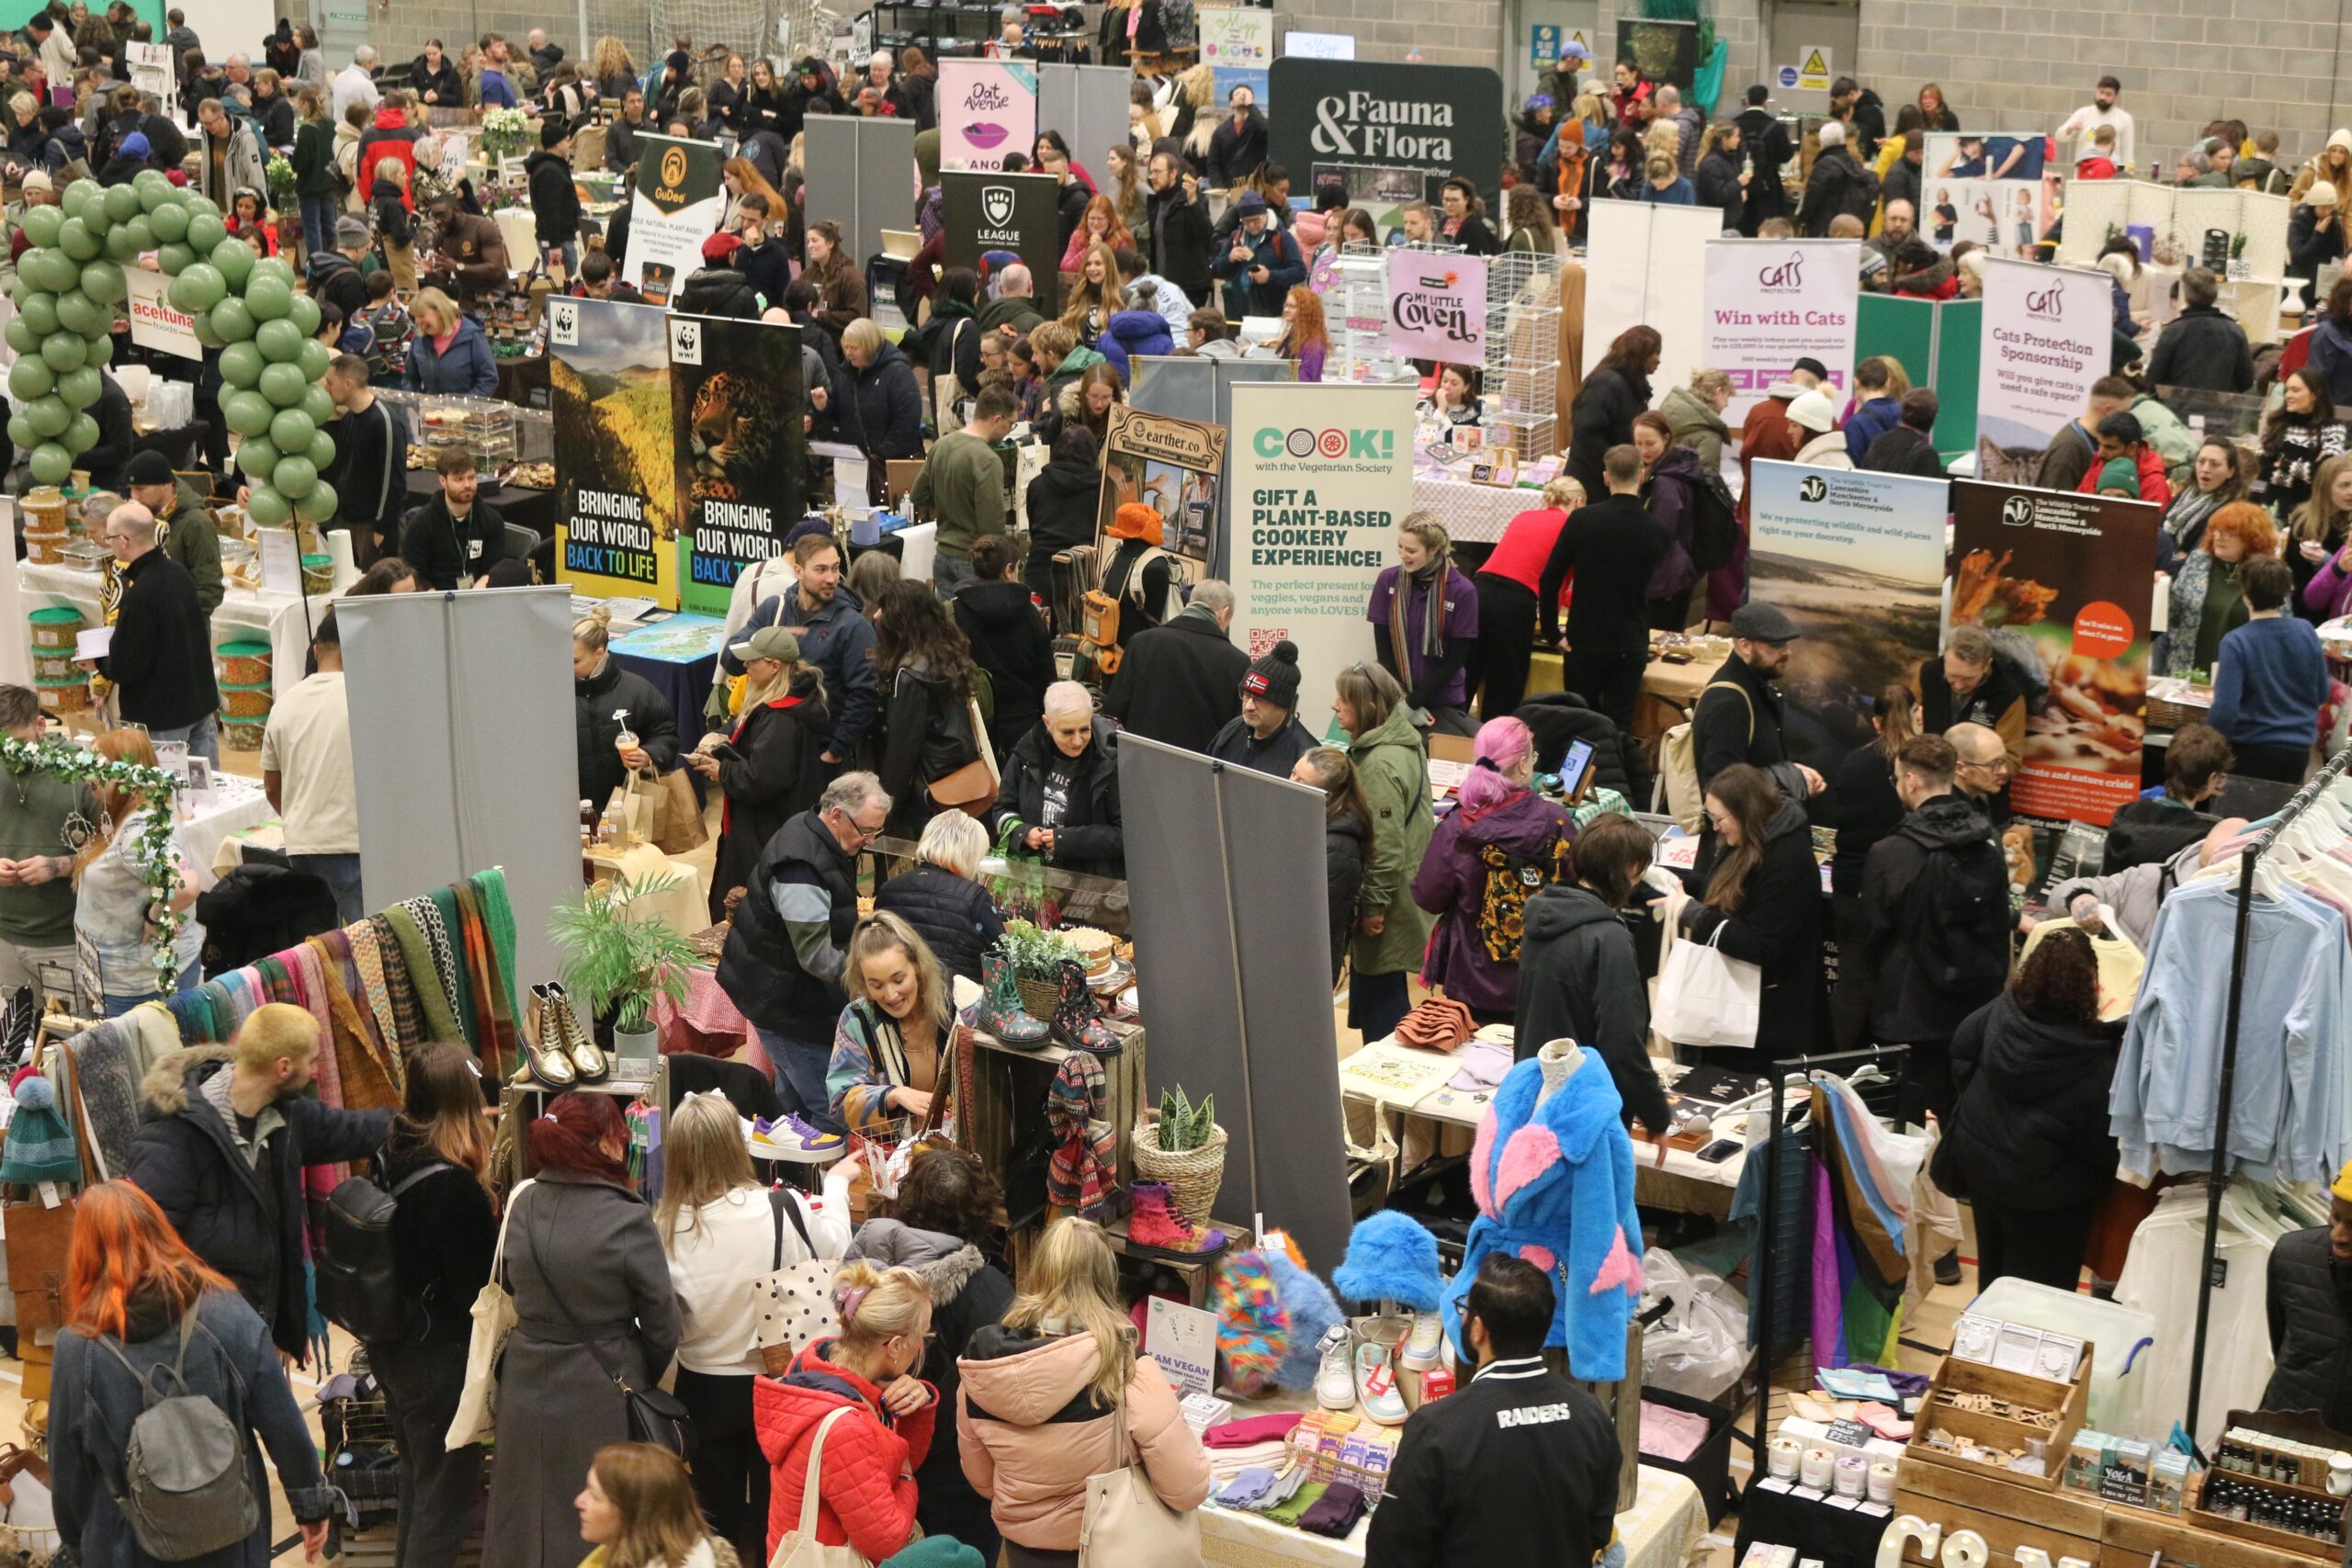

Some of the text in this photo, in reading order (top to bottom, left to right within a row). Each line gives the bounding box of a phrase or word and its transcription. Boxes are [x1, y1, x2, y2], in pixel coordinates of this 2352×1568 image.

[972, 82, 1001, 99] Oat
[964, 96, 1010, 110] Avenue
[1348, 91, 1453, 127] Fauna
[1311, 96, 1356, 155] &
[1363, 125, 1453, 161] Flora
[978, 229, 1020, 241] LEAGUE
[1759, 250, 1804, 287] CATS
[1415, 293, 1463, 308] MY LITTLE
[2027, 277, 2064, 316] CATS
[133, 302, 195, 329] aceituna
[1393, 293, 1477, 344] Coven
[1714, 310, 1846, 326] Win with Cats
[557, 333, 571, 341] WWF
[1993, 327, 2093, 356] Cats Protection
[678, 351, 694, 359] WWF
[2001, 345, 2083, 372] Sponsorship
[1997, 369, 2084, 392] Will you give cats in
[1999, 382, 2022, 393] need
[2030, 387, 2049, 398] safe
[2050, 391, 2081, 402] space?
[1147, 431, 1200, 452] earther.co
[1253, 427, 1394, 459] COOK!
[1255, 462, 1393, 475] with the Vegetarian Society
[579, 490, 642, 521] BRINGING
[1253, 490, 1317, 506] GIFT A
[705, 500, 773, 533] BRINGING
[1252, 509, 1392, 527] PLANT-BASED
[1759, 512, 1931, 541] We're protecting wildlife and wild places
[571, 516, 650, 551] OUR WORLD
[696, 527, 782, 560] OUR WORLD
[1252, 529, 1349, 547] COOKERY
[1758, 525, 1780, 536] right
[1794, 530, 1814, 539] your
[1815, 532, 1856, 545] doorstep.
[567, 543, 654, 581] BACK TO LIFE
[1251, 549, 1382, 567] EXPERIENCE!
[694, 555, 732, 584] BACK
[1251, 580, 1375, 592] The perfect present for
[1251, 593, 1364, 604] veggies, vegans and
[1250, 607, 1293, 617] anyone
[1294, 606, 1317, 615] who
[1321, 606, 1360, 616] LOVES
[2020, 765, 2134, 790] limate and nature crisis
[1155, 1354, 1171, 1365] AM
[1174, 1359, 1210, 1376] VEGAN
[1497, 1403, 1571, 1428] RAIDERS
[2105, 1468, 2133, 1483] YOGA
